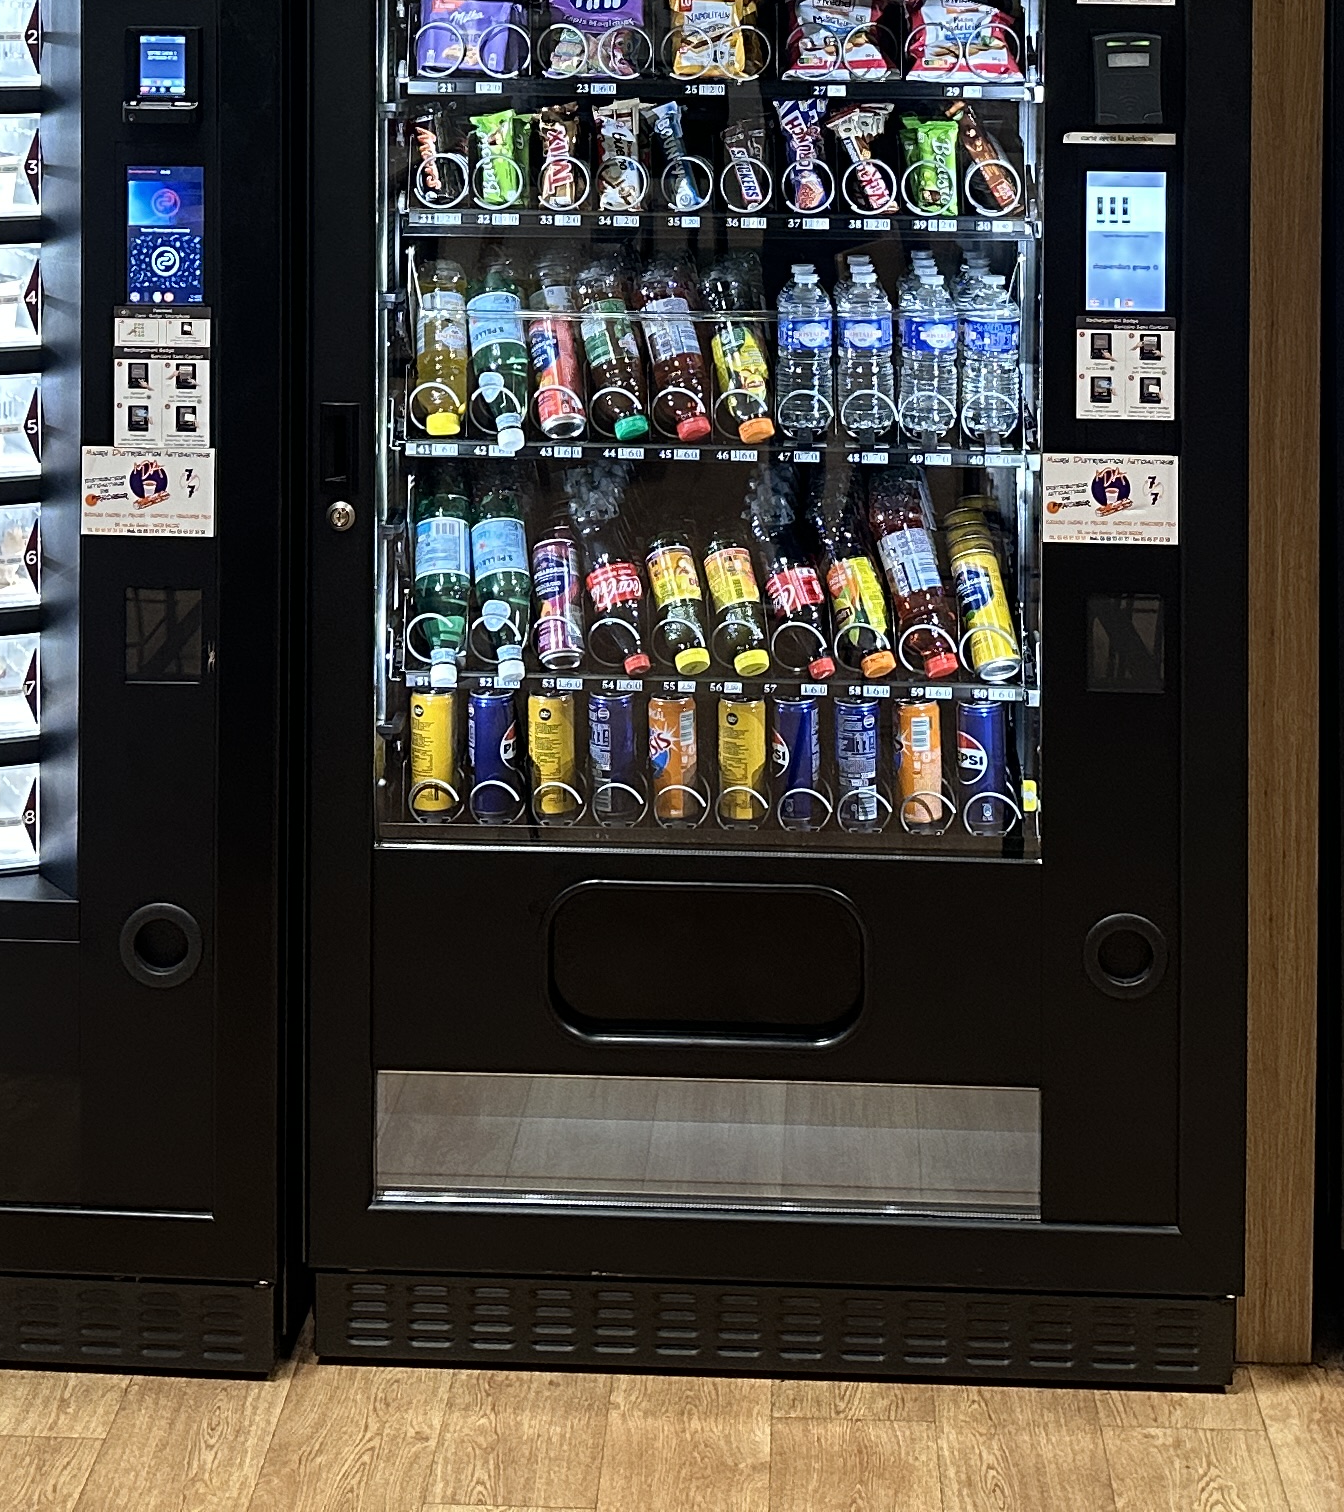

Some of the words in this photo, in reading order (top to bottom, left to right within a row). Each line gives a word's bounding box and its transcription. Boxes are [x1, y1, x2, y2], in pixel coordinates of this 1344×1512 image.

[450, 10, 485, 25] Milka
[27, 29, 39, 44] 2
[439, 82, 453, 93] 21
[576, 83, 589, 93] 23
[812, 86, 826, 95] 27
[946, 87, 960, 97] 29
[27, 159, 38, 174] 3
[419, 214, 432, 224] 31
[477, 214, 490, 224] 32
[540, 215, 553, 225] 33
[598, 216, 611, 225] 34
[668, 217, 680, 226] 35
[726, 218, 739, 227] 36
[787, 218, 801, 228] 37
[848, 219, 862, 229] 38
[913, 220, 927, 230] 39
[26, 290, 37, 305] 4
[27, 419, 38, 434] 5
[418, 445, 430, 454] 41
[474, 445, 487, 455] 42
[539, 447, 552, 457] 43
[603, 449, 616, 458] 44
[659, 449, 671, 458] 45
[716, 451, 729, 459] 46
[778, 453, 791, 461] 47
[847, 454, 860, 462] 48
[909, 455, 923, 464] 49
[969, 455, 983, 465] 40
[185, 468, 193, 481] 7
[1148, 476, 1156, 489] 7
[187, 485, 196, 498] 7
[1151, 492, 1159, 505] 7
[26, 550, 37, 565] 6
[480, 678, 492, 687] 52
[542, 679, 554, 688] 53
[601, 681, 614, 689] 54
[663, 682, 676, 690] 55
[710, 683, 723, 692] 56
[26, 681, 36, 696] 7
[764, 684, 777, 693] 57
[849, 686, 861, 695] 58
[911, 688, 924, 697] 59
[24, 809, 35, 824] 8
